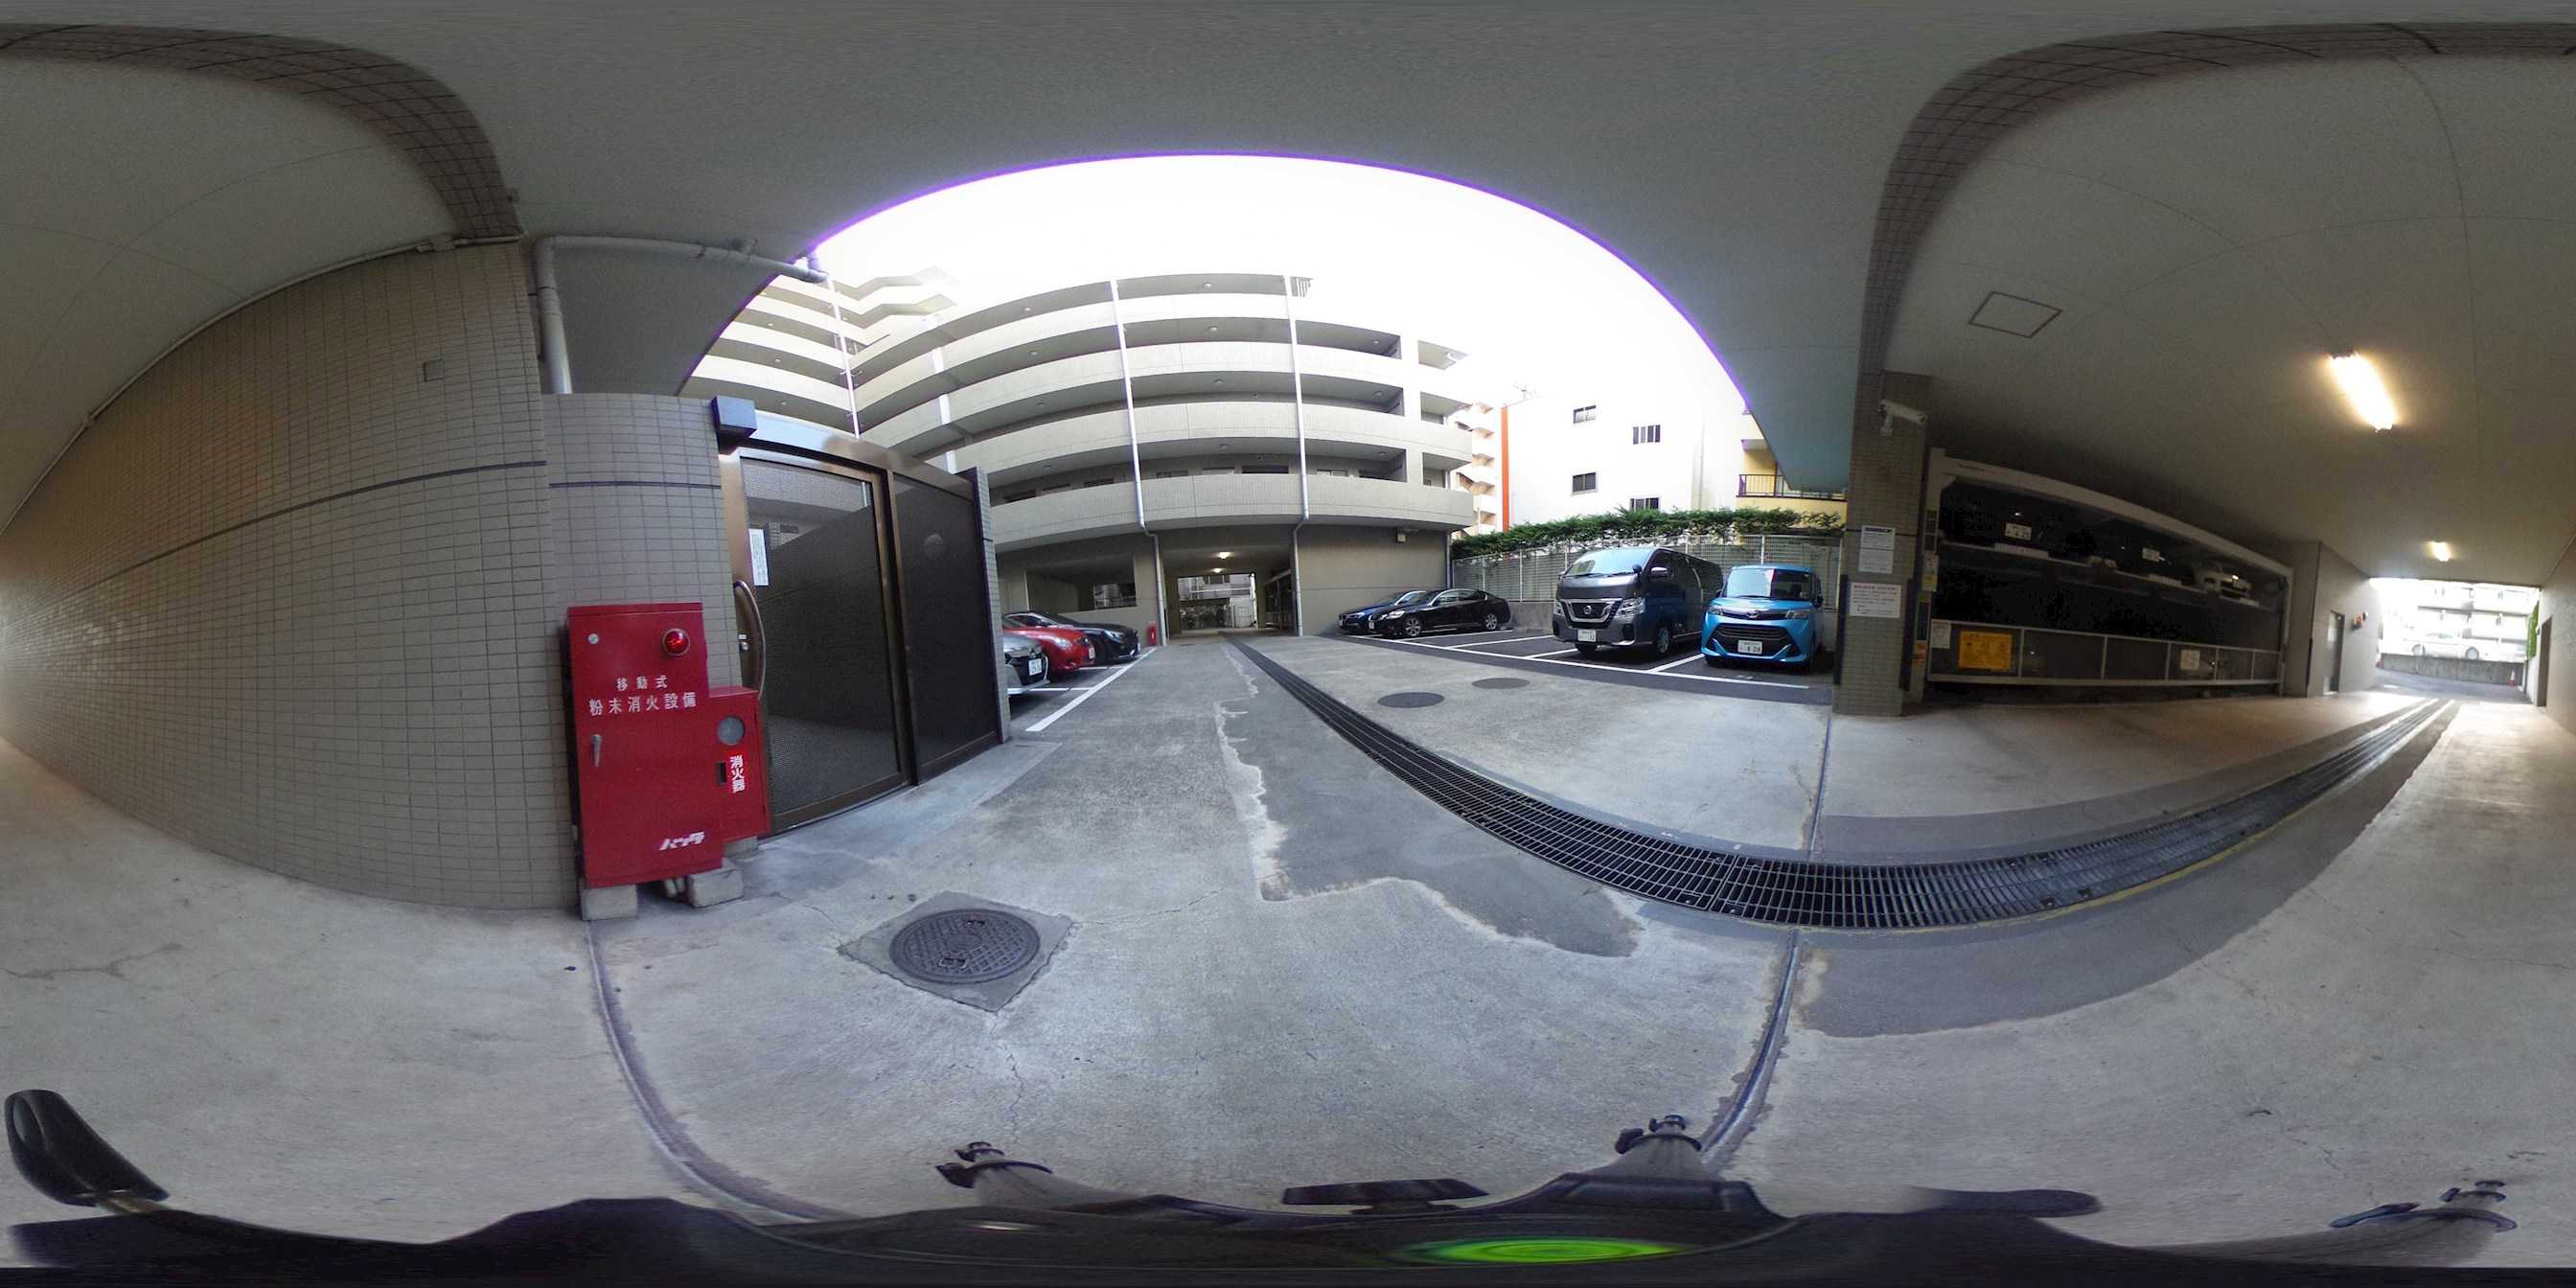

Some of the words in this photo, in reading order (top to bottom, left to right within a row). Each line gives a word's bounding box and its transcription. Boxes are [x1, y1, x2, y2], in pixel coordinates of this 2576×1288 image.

[616, 675, 668, 691] 移動式
[588, 691, 697, 716] 粉末消火設備
